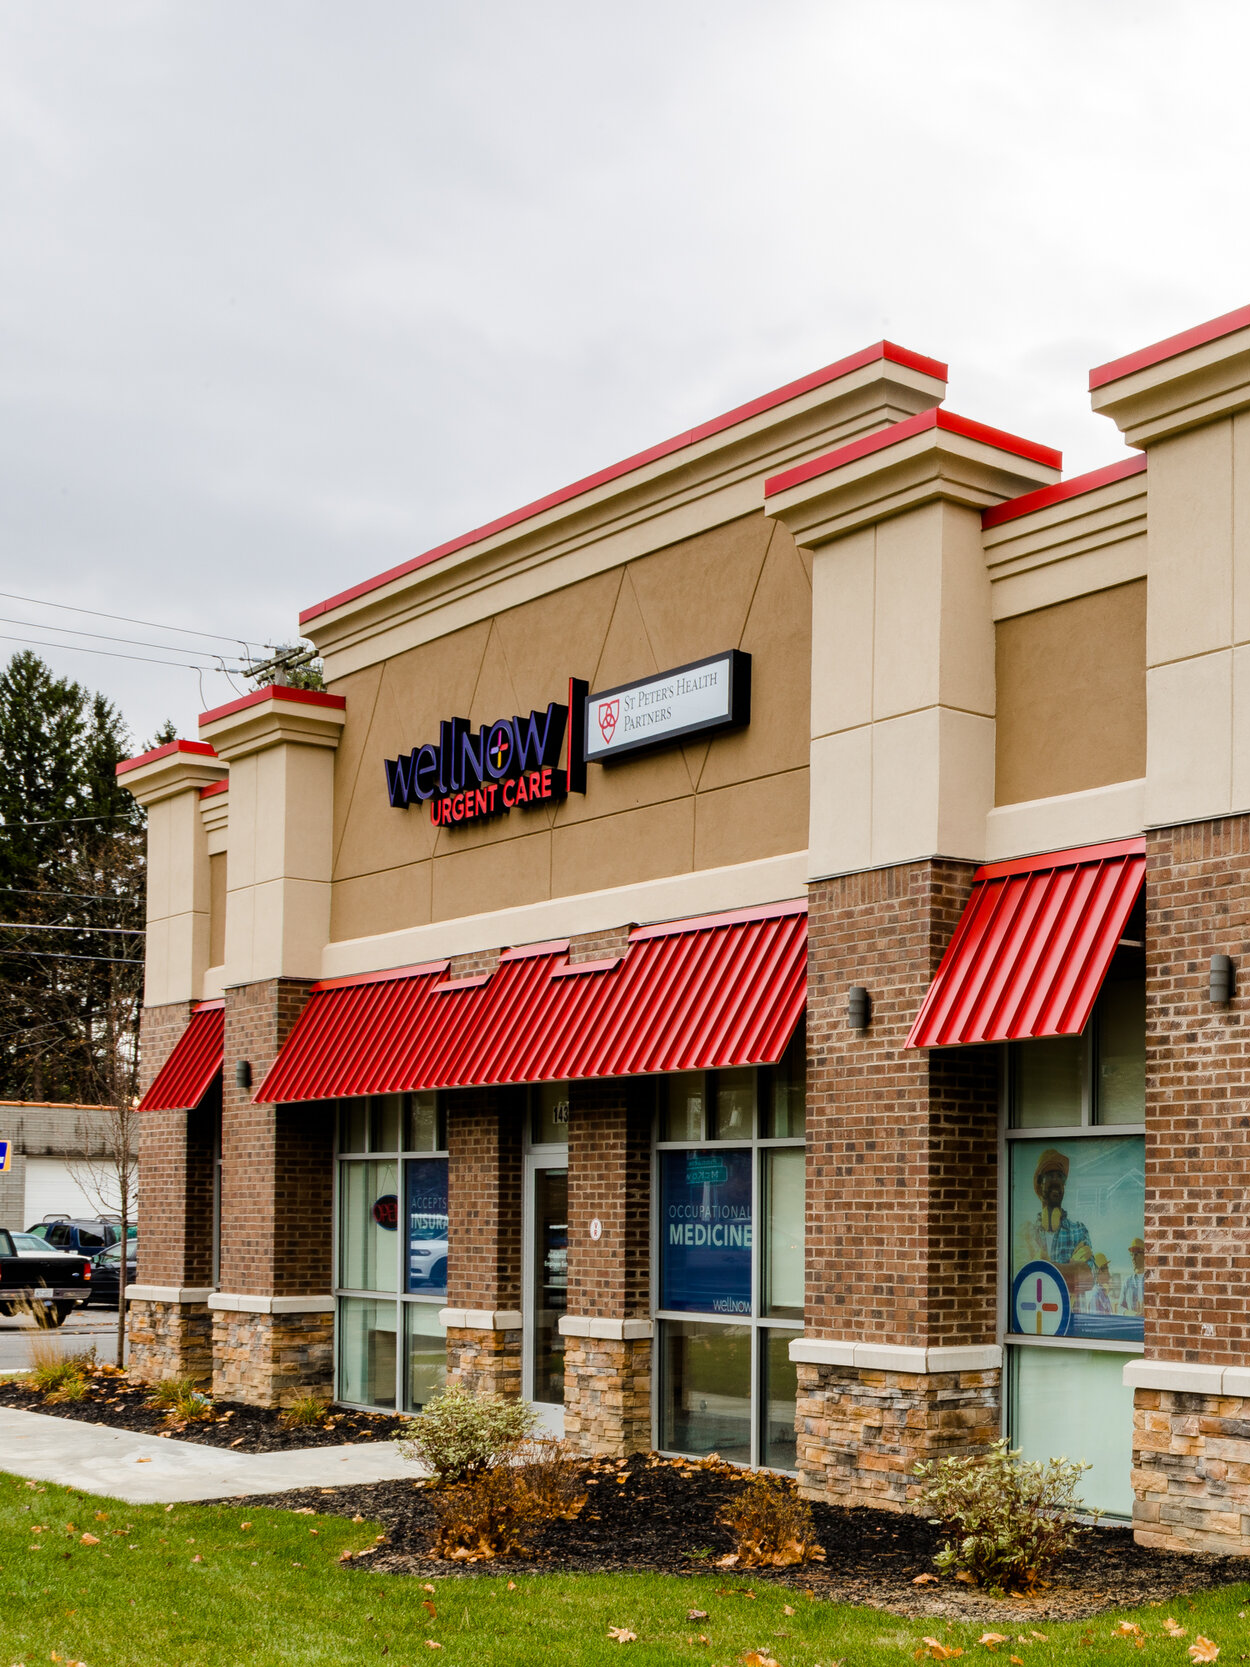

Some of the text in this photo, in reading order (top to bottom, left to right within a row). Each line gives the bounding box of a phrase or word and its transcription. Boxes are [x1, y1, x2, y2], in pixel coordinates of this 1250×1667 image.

[431, 768, 552, 826] URGENT CARE
[411, 1196, 447, 1210] ACCEPTS
[669, 1204, 752, 1219] OCCUPATIONAL
[669, 1223, 752, 1247] MEDICINE
